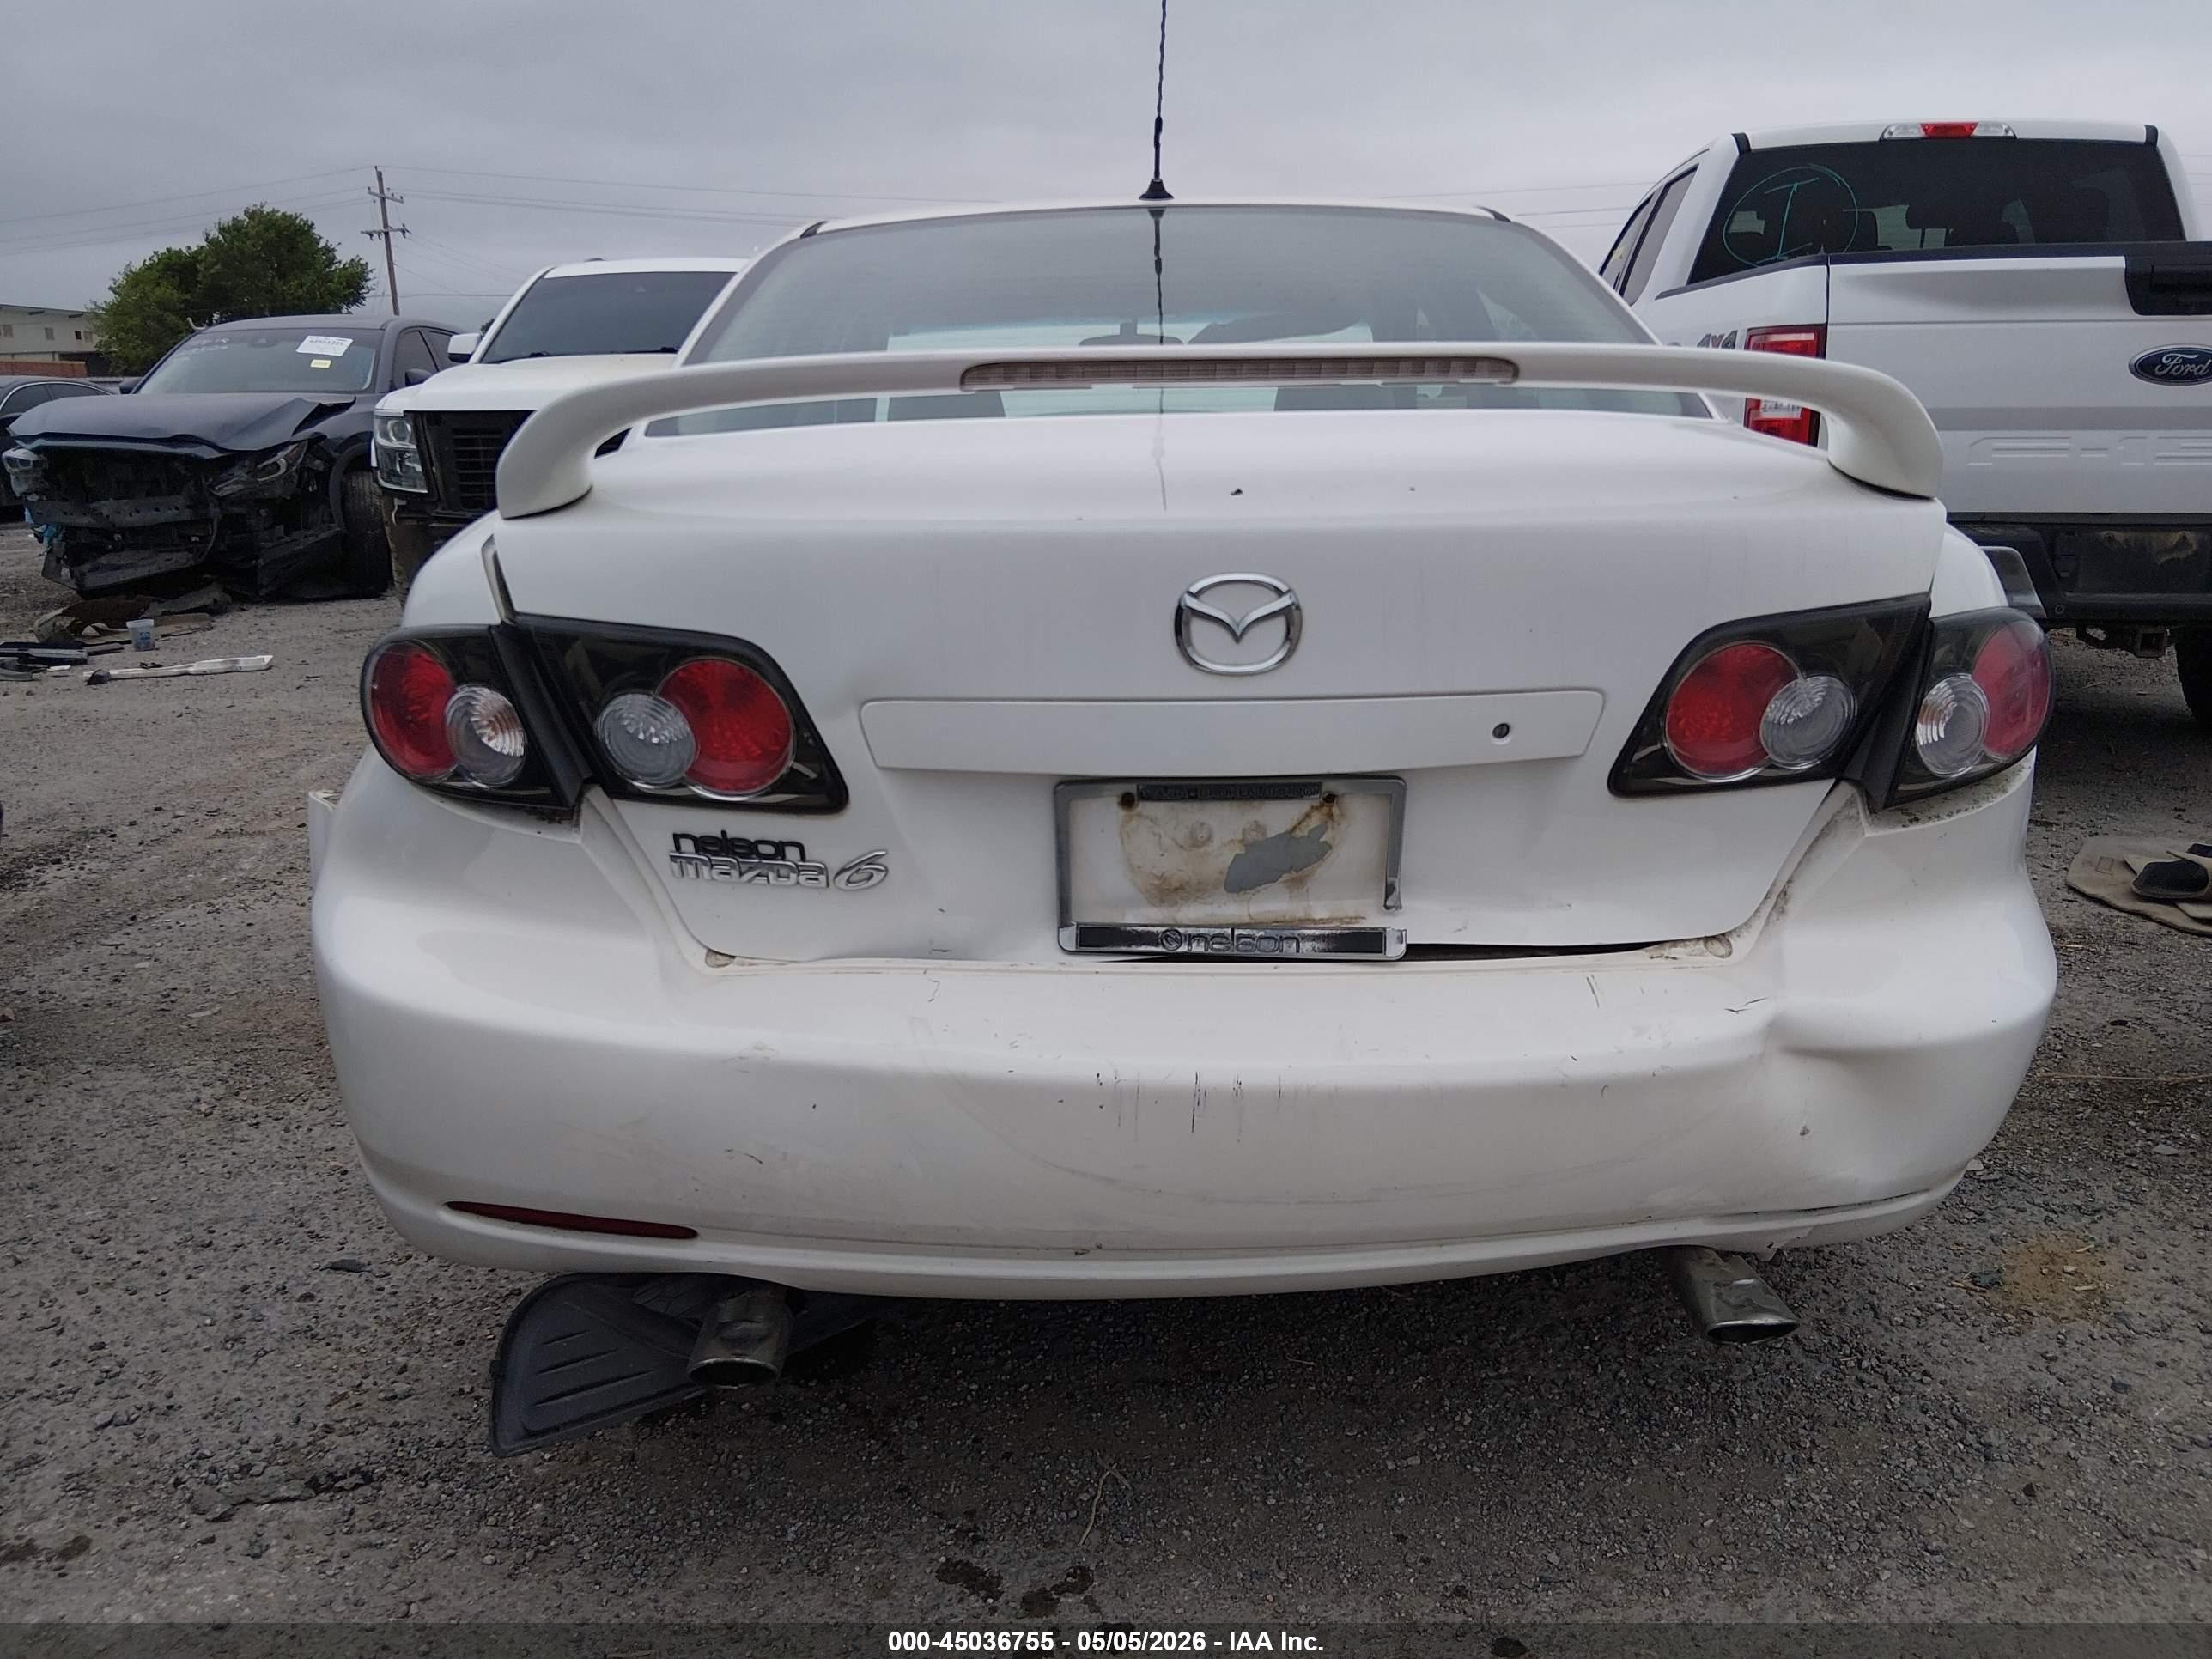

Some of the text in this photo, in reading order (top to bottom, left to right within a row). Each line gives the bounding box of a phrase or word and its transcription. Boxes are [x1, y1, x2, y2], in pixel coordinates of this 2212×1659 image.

[2154, 353, 2212, 376] Ford
[672, 830, 806, 863] nelson
[1187, 927, 1301, 953] nelson
